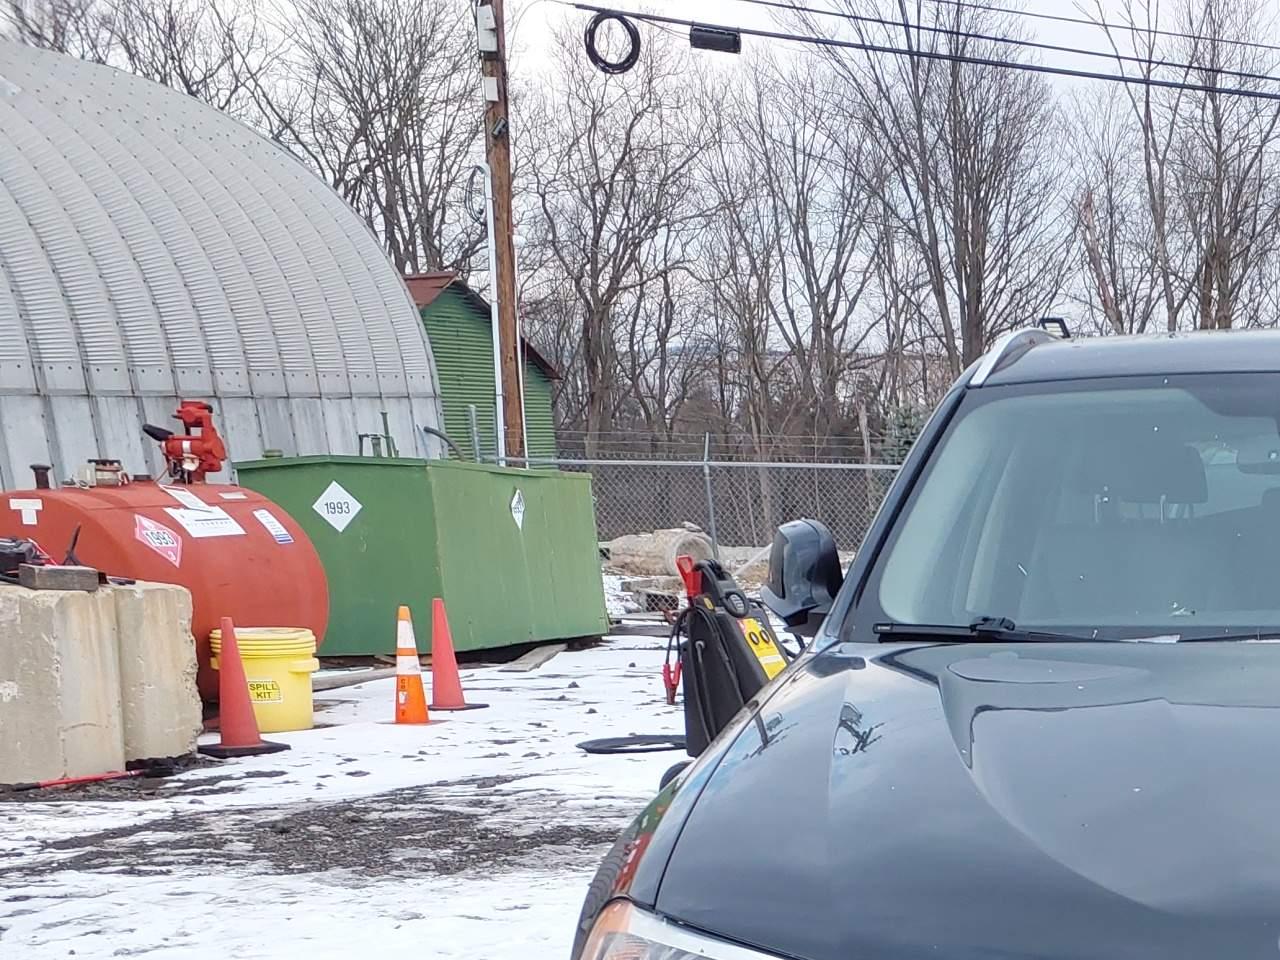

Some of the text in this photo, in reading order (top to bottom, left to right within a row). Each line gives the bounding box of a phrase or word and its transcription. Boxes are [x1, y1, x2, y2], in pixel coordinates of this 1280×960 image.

[324, 501, 351, 515] 1993
[145, 530, 175, 546] 1993
[249, 683, 278, 691] SPILL
[256, 691, 273, 699] KIT
